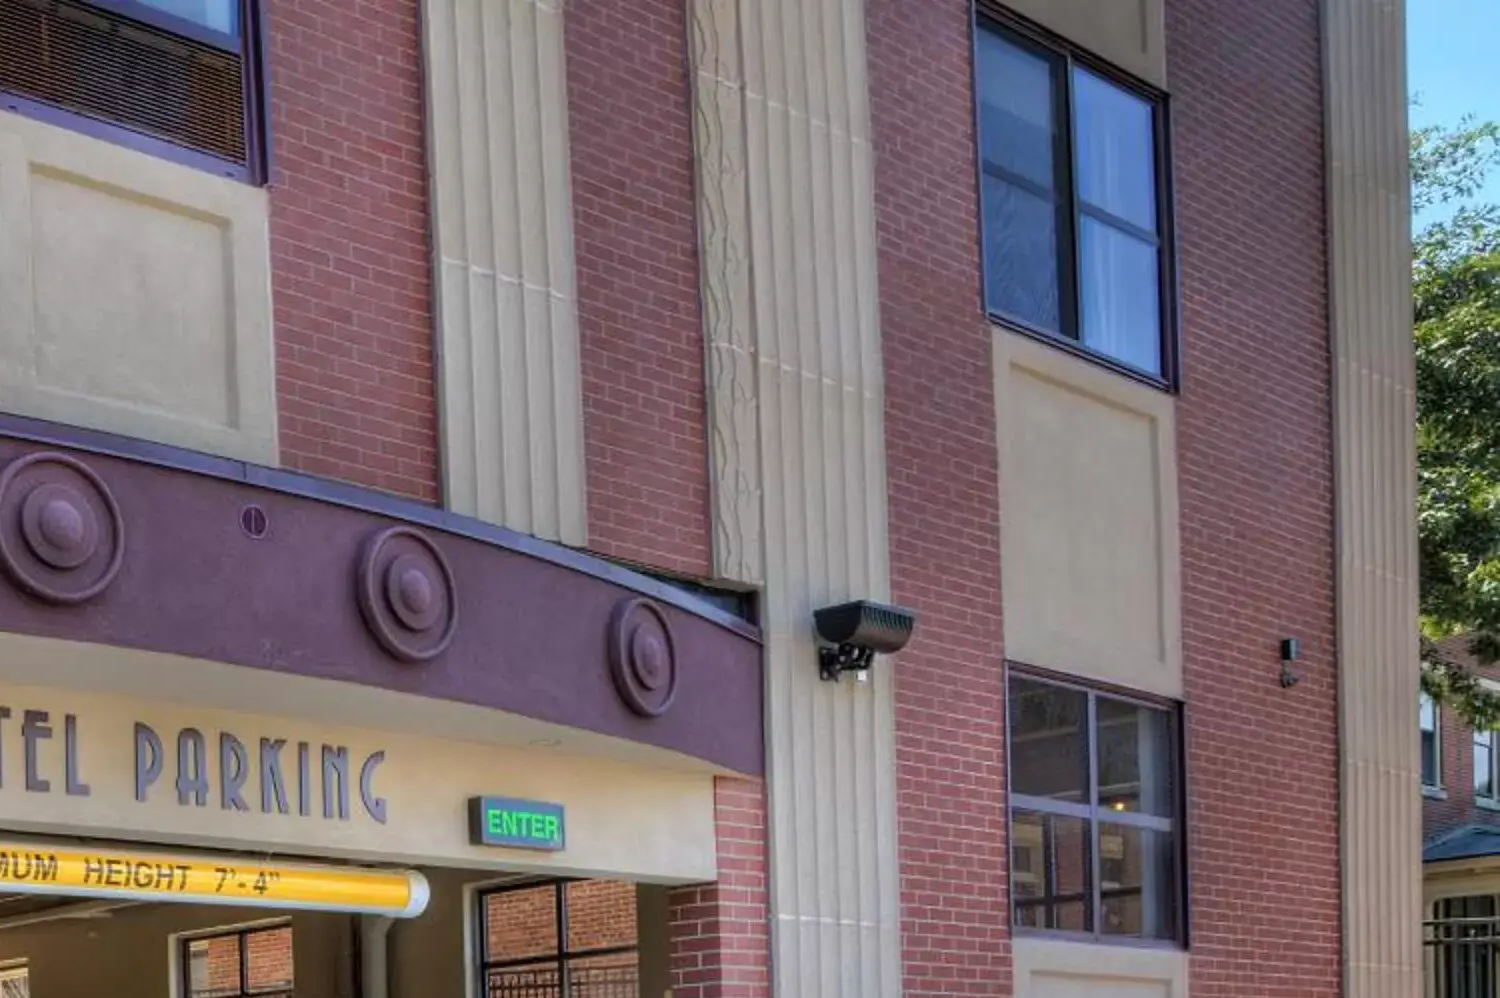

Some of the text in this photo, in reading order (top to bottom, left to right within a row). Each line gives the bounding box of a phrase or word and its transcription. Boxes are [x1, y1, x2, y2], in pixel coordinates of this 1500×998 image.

[133, 720, 388, 825] PARKING
[487, 809, 560, 840] ENTER
[83, 856, 192, 892] HEIGHT
